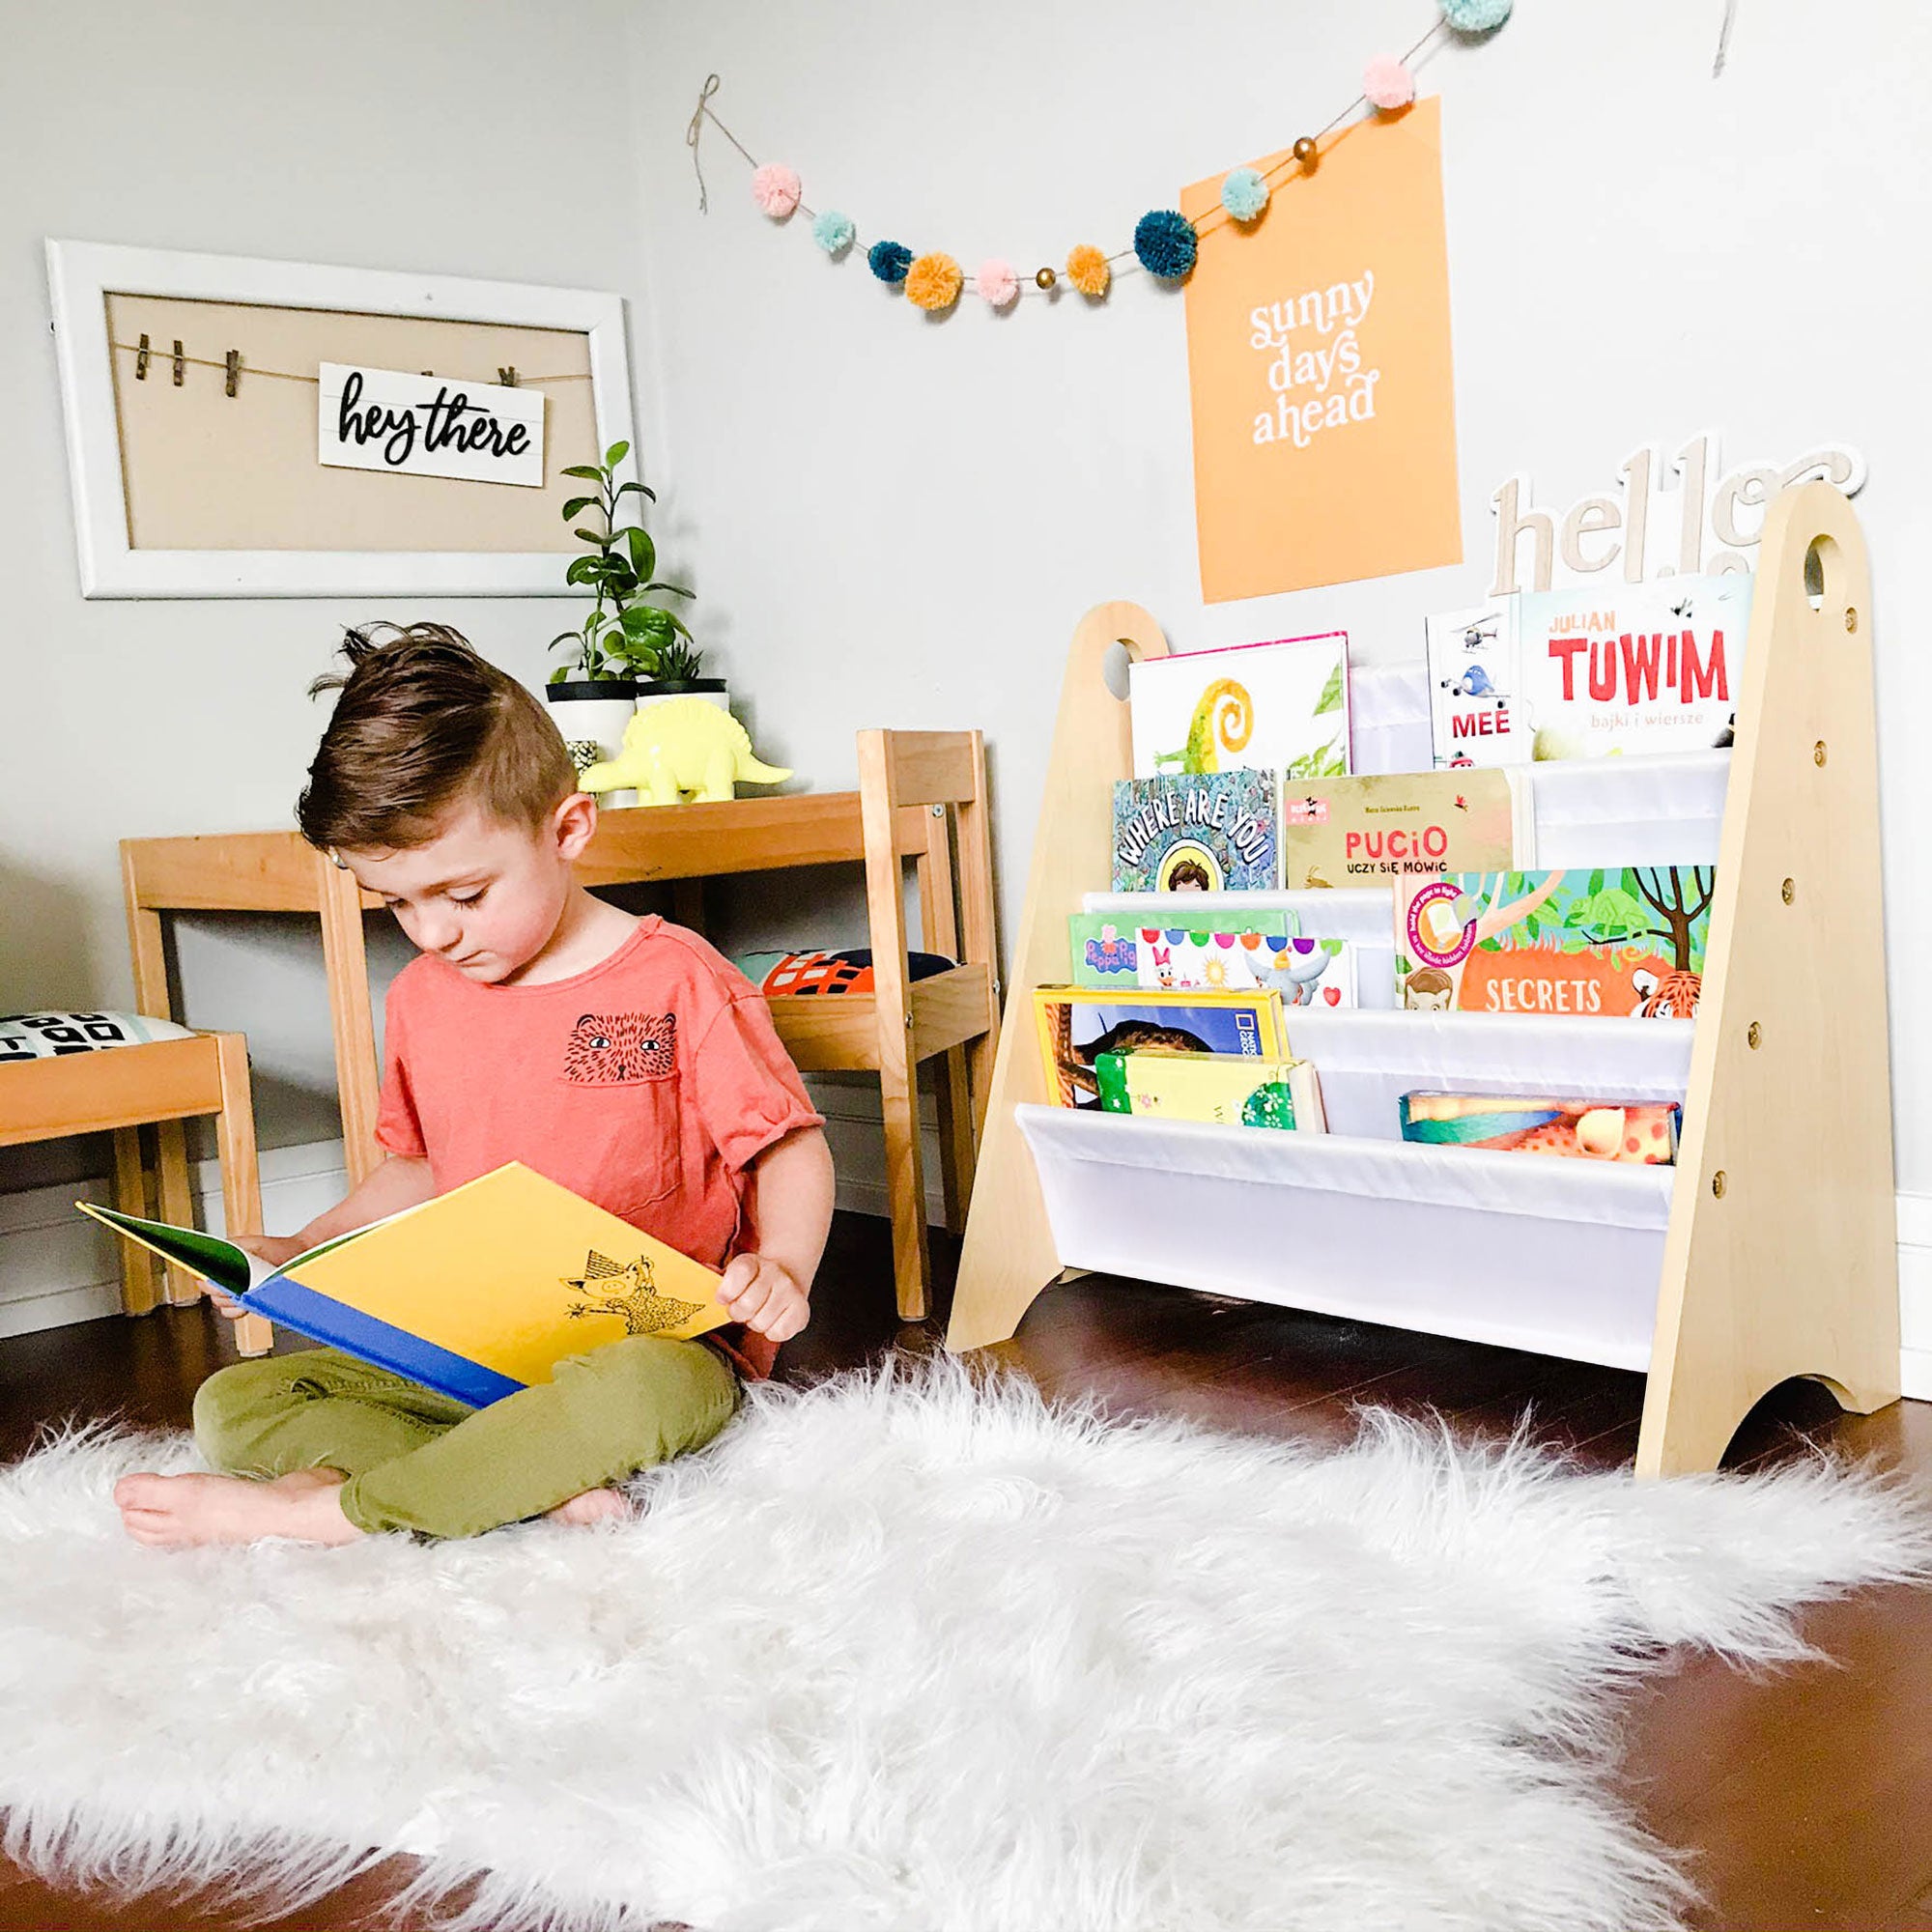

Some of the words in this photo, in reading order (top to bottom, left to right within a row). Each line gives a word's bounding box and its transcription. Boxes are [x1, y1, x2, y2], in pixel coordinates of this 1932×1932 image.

[1250, 270, 1374, 349] sunny
[1268, 329, 1360, 392] days
[339, 372, 421, 465] hey
[415, 386, 530, 457] there
[1252, 369, 1379, 448] ahead
[1548, 611, 1616, 633] JULIAN
[1548, 630, 1729, 705] TUWIM
[1452, 710, 1510, 738] MEE
[1591, 713, 1629, 732] bajki
[1634, 712, 1640, 726] i
[1644, 712, 1704, 726] wiersze
[1119, 791, 1180, 867] WHERE
[1184, 788, 1228, 830] ARE
[1227, 806, 1270, 865] YOU
[1347, 863, 1376, 873] UCZY
[1086, 942, 1120, 970] Peppa
[1120, 941, 1136, 968] Pig
[1485, 978, 1602, 1012] SECRETS
